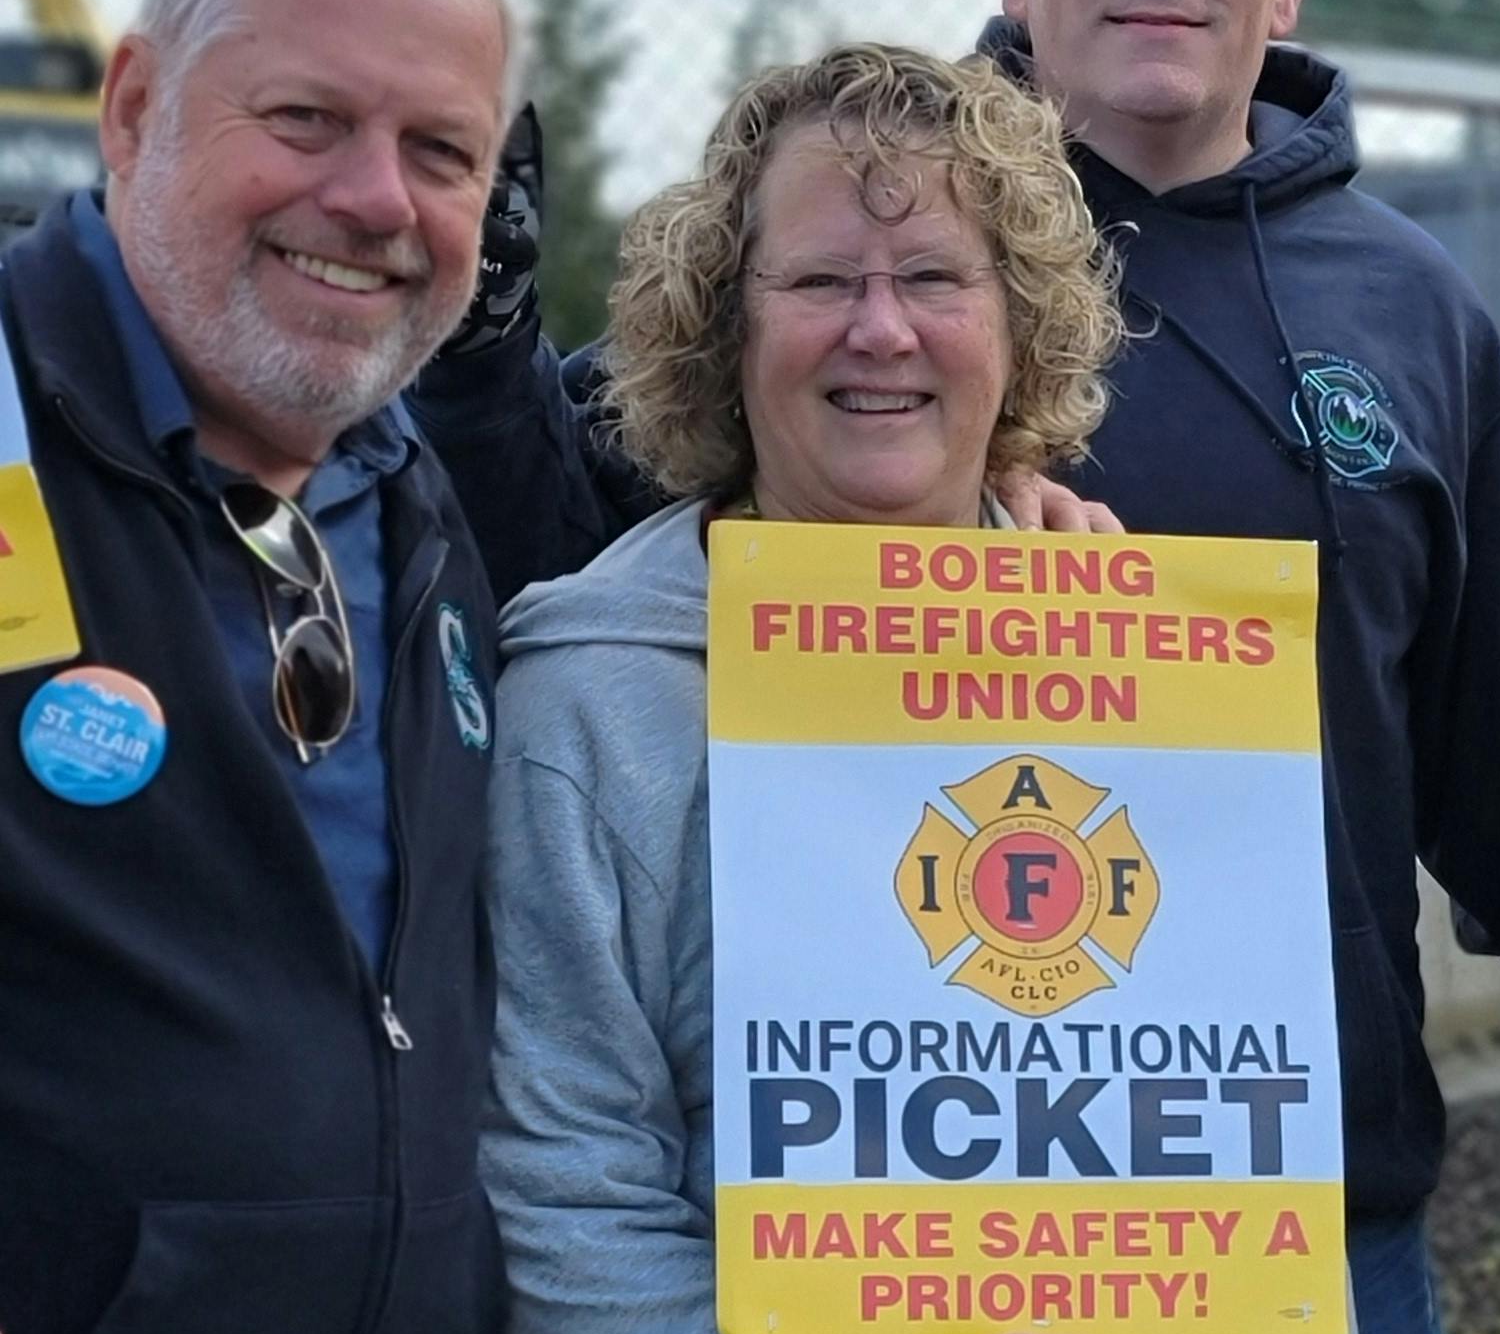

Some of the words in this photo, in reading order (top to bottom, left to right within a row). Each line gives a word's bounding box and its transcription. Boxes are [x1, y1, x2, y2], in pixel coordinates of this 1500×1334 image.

[878, 542, 1155, 597] BOEING
[752, 603, 1277, 667] FIREFIGHTERS
[902, 672, 1138, 723] UNION
[39, 703, 74, 733] ST.
[80, 720, 149, 764] CLAIR
[1001, 765, 1053, 811] A
[917, 854, 942, 913] I
[1002, 852, 1057, 922] F
[1107, 858, 1141, 917] F
[1011, 985, 1058, 1001] CLC
[745, 1019, 1310, 1075] INFORMATIONAL
[749, 1076, 1309, 1182] PICKET
[752, 1212, 955, 1260] MAKE
[979, 1208, 1243, 1259] SAFETY
[1264, 1210, 1311, 1256] A
[859, 1272, 1209, 1323] PRIORITY!
